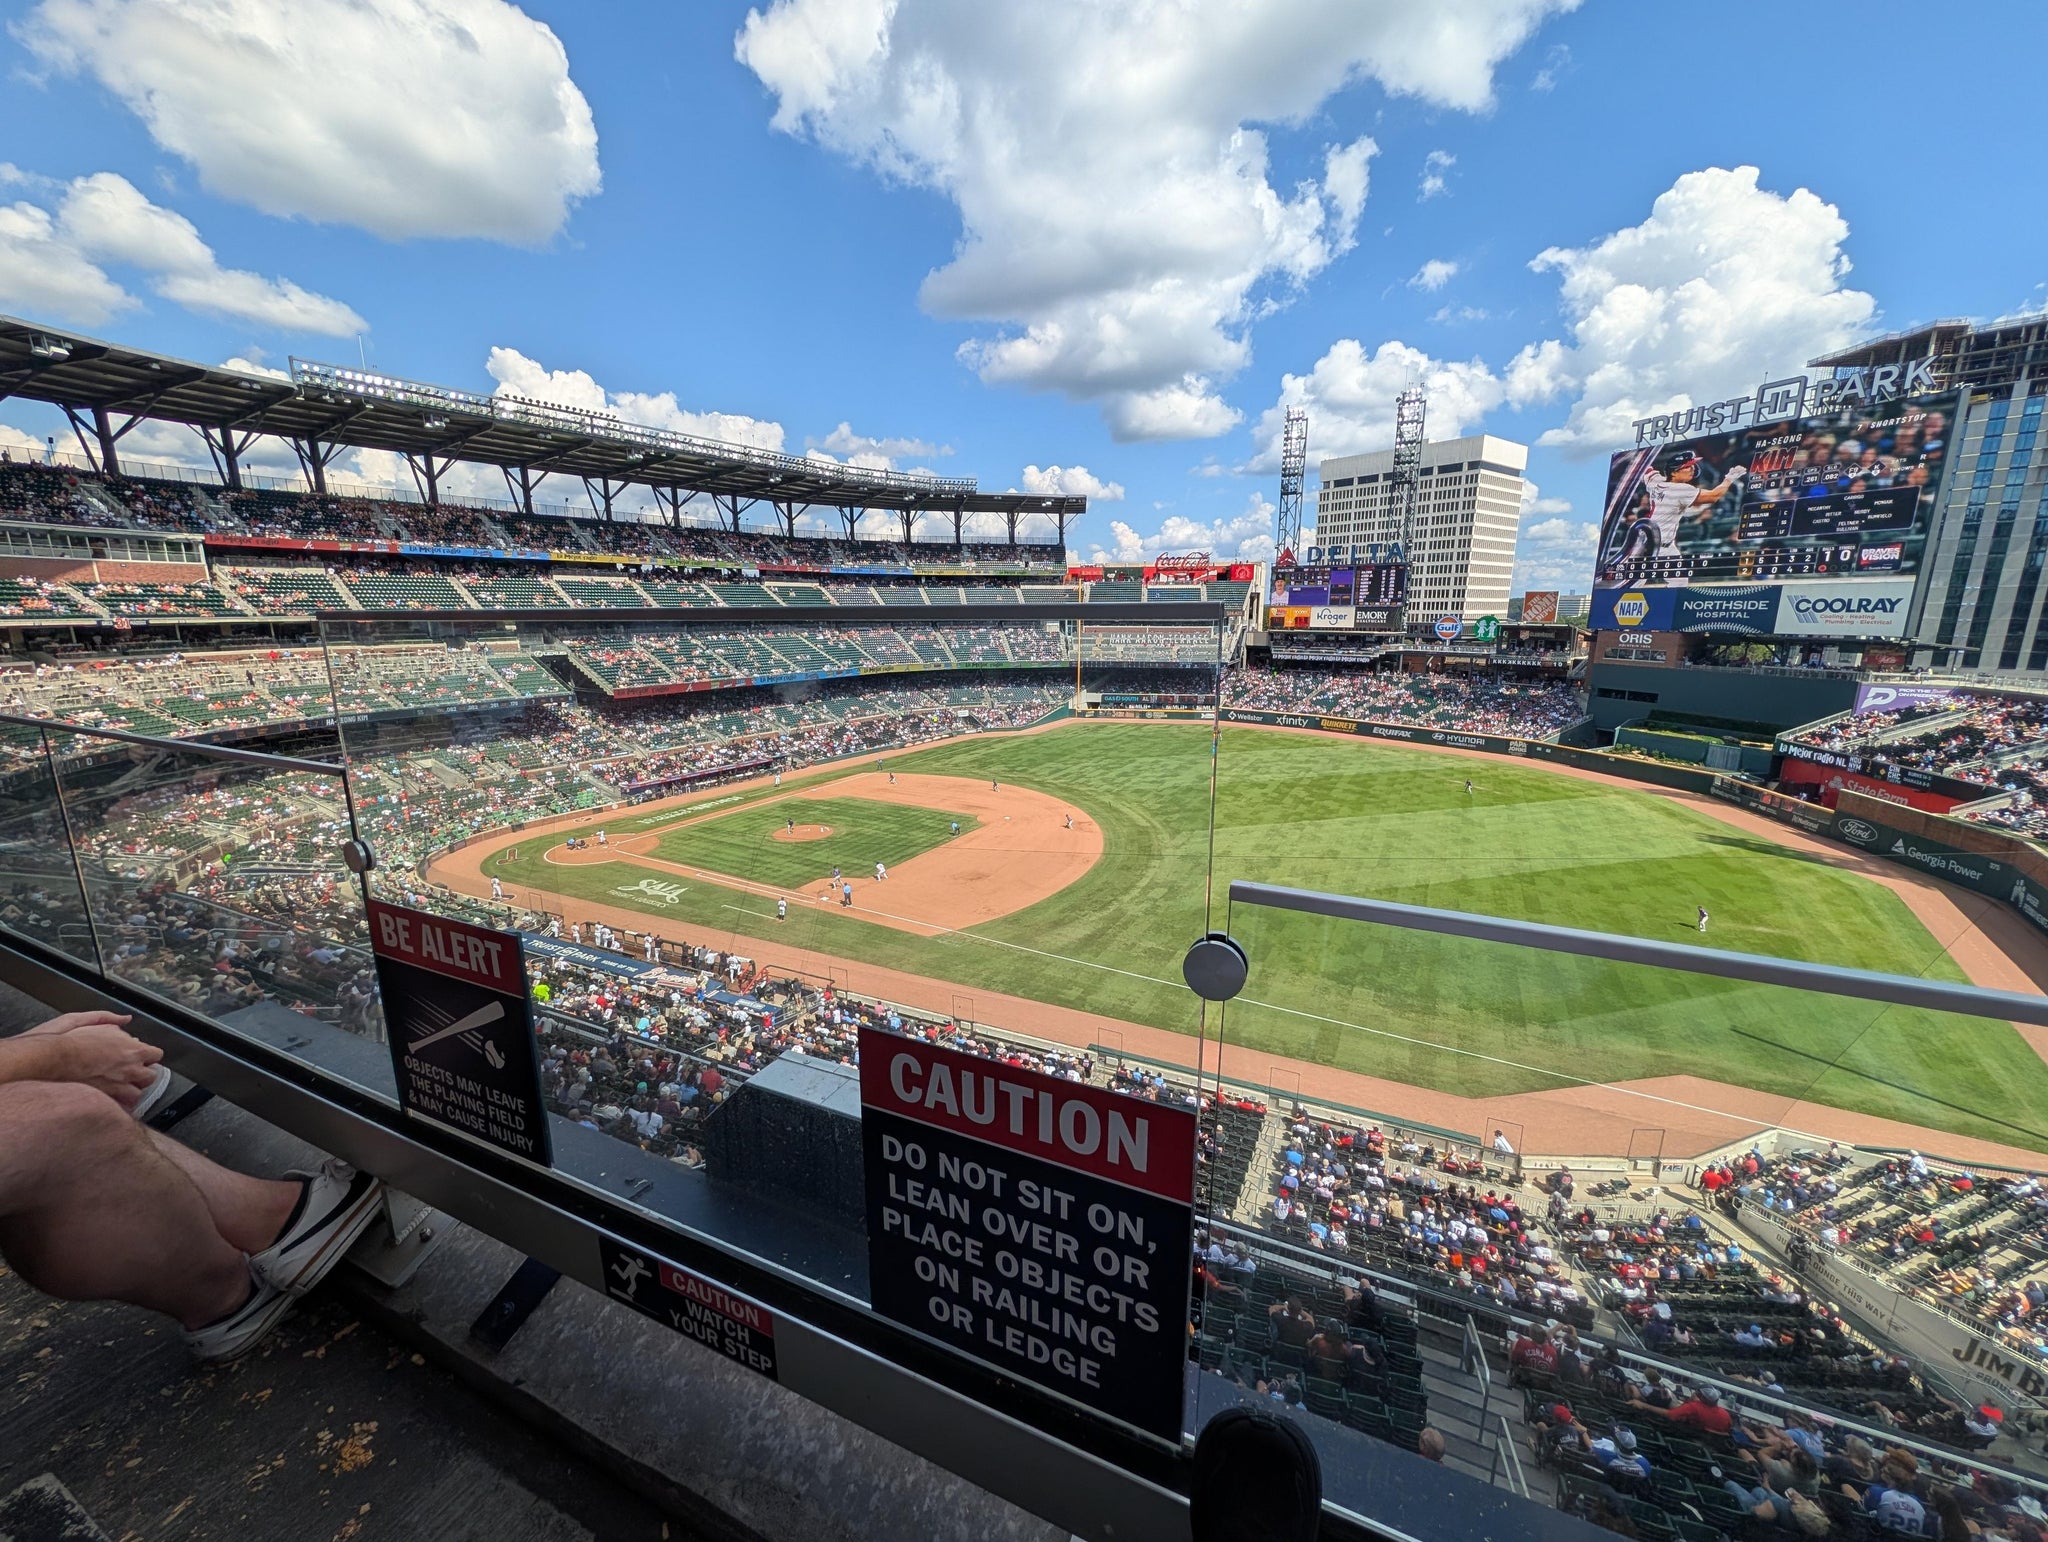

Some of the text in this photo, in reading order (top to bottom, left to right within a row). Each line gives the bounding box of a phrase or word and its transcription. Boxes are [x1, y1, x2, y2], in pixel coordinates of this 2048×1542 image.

[1632, 355, 1938, 443] TRUIST PARK
[1870, 413, 1927, 430] SHORTSTOP
[1755, 433, 1802, 448] HA-SEONG
[1750, 446, 1798, 473] KIM
[1308, 542, 1405, 563] DELTA
[1702, 559, 1708, 567] 0
[1789, 555, 1796, 563] 3
[1805, 554, 1811, 562] 2
[1824, 550, 1851, 561] 1 0
[1861, 547, 1900, 557] BRAVES
[1861, 552, 1899, 561] VISION
[1771, 566, 1777, 574] 0
[1803, 565, 1809, 573] 2
[1356, 611, 1389, 620] EMORY
[1524, 592, 1557, 621] HOME
[1535, 603, 1557, 621] DEPOT
[1619, 602, 1643, 617] NAPA
[1683, 600, 1770, 611] NORTHSIDE
[1696, 611, 1750, 619] HOSPITAL
[1795, 598, 1904, 614] COOLRAY
[1317, 608, 1348, 626] Kroger
[1437, 622, 1460, 632] Gulf
[1110, 633, 1132, 645] HANK
[1136, 633, 1165, 645] AARON
[1619, 633, 1652, 645] ORIS
[1237, 713, 1264, 722] Wellstar
[1276, 715, 1309, 728] xfinity
[1320, 719, 1358, 731] QUIKRETE
[1372, 726, 1412, 738] EQUIFAX
[1446, 735, 1485, 746] HYUNDAI
[1788, 745, 1813, 760] Mejor
[1813, 752, 1834, 765] radio
[1836, 758, 1847, 768] NL
[1846, 820, 1873, 841] Ford
[1907, 846, 1983, 881] Georgia Power
[378, 912, 502, 979] BE ALERT
[529, 939, 563, 952] TRUIST
[571, 949, 601, 963] PARK
[404, 1055, 526, 1114] OBJECTS MAY LEAVE
[410, 1073, 525, 1131] THE PLAYING FIELD
[408, 1089, 533, 1152] & MAY CAUSE INJURY
[890, 1052, 1148, 1174] CAUTION
[882, 1134, 1157, 1255] DO NOT SIT ON,
[889, 1173, 1150, 1290] LEAN OVER OR
[882, 1206, 1160, 1333] PLACE OBJECTS
[672, 1272, 760, 1327] CAUTION
[1808, 1258, 1840, 1287] LOUNGE
[1843, 1283, 1864, 1304] THIS
[1865, 1302, 1886, 1320] WAY
[914, 1256, 1117, 1357] ON RAILING
[685, 1299, 750, 1345] WATCH
[669, 1309, 772, 1372] YOUR STEP
[929, 1296, 1100, 1388] OR LEDGE
[1952, 1337, 2017, 1381] JIM
